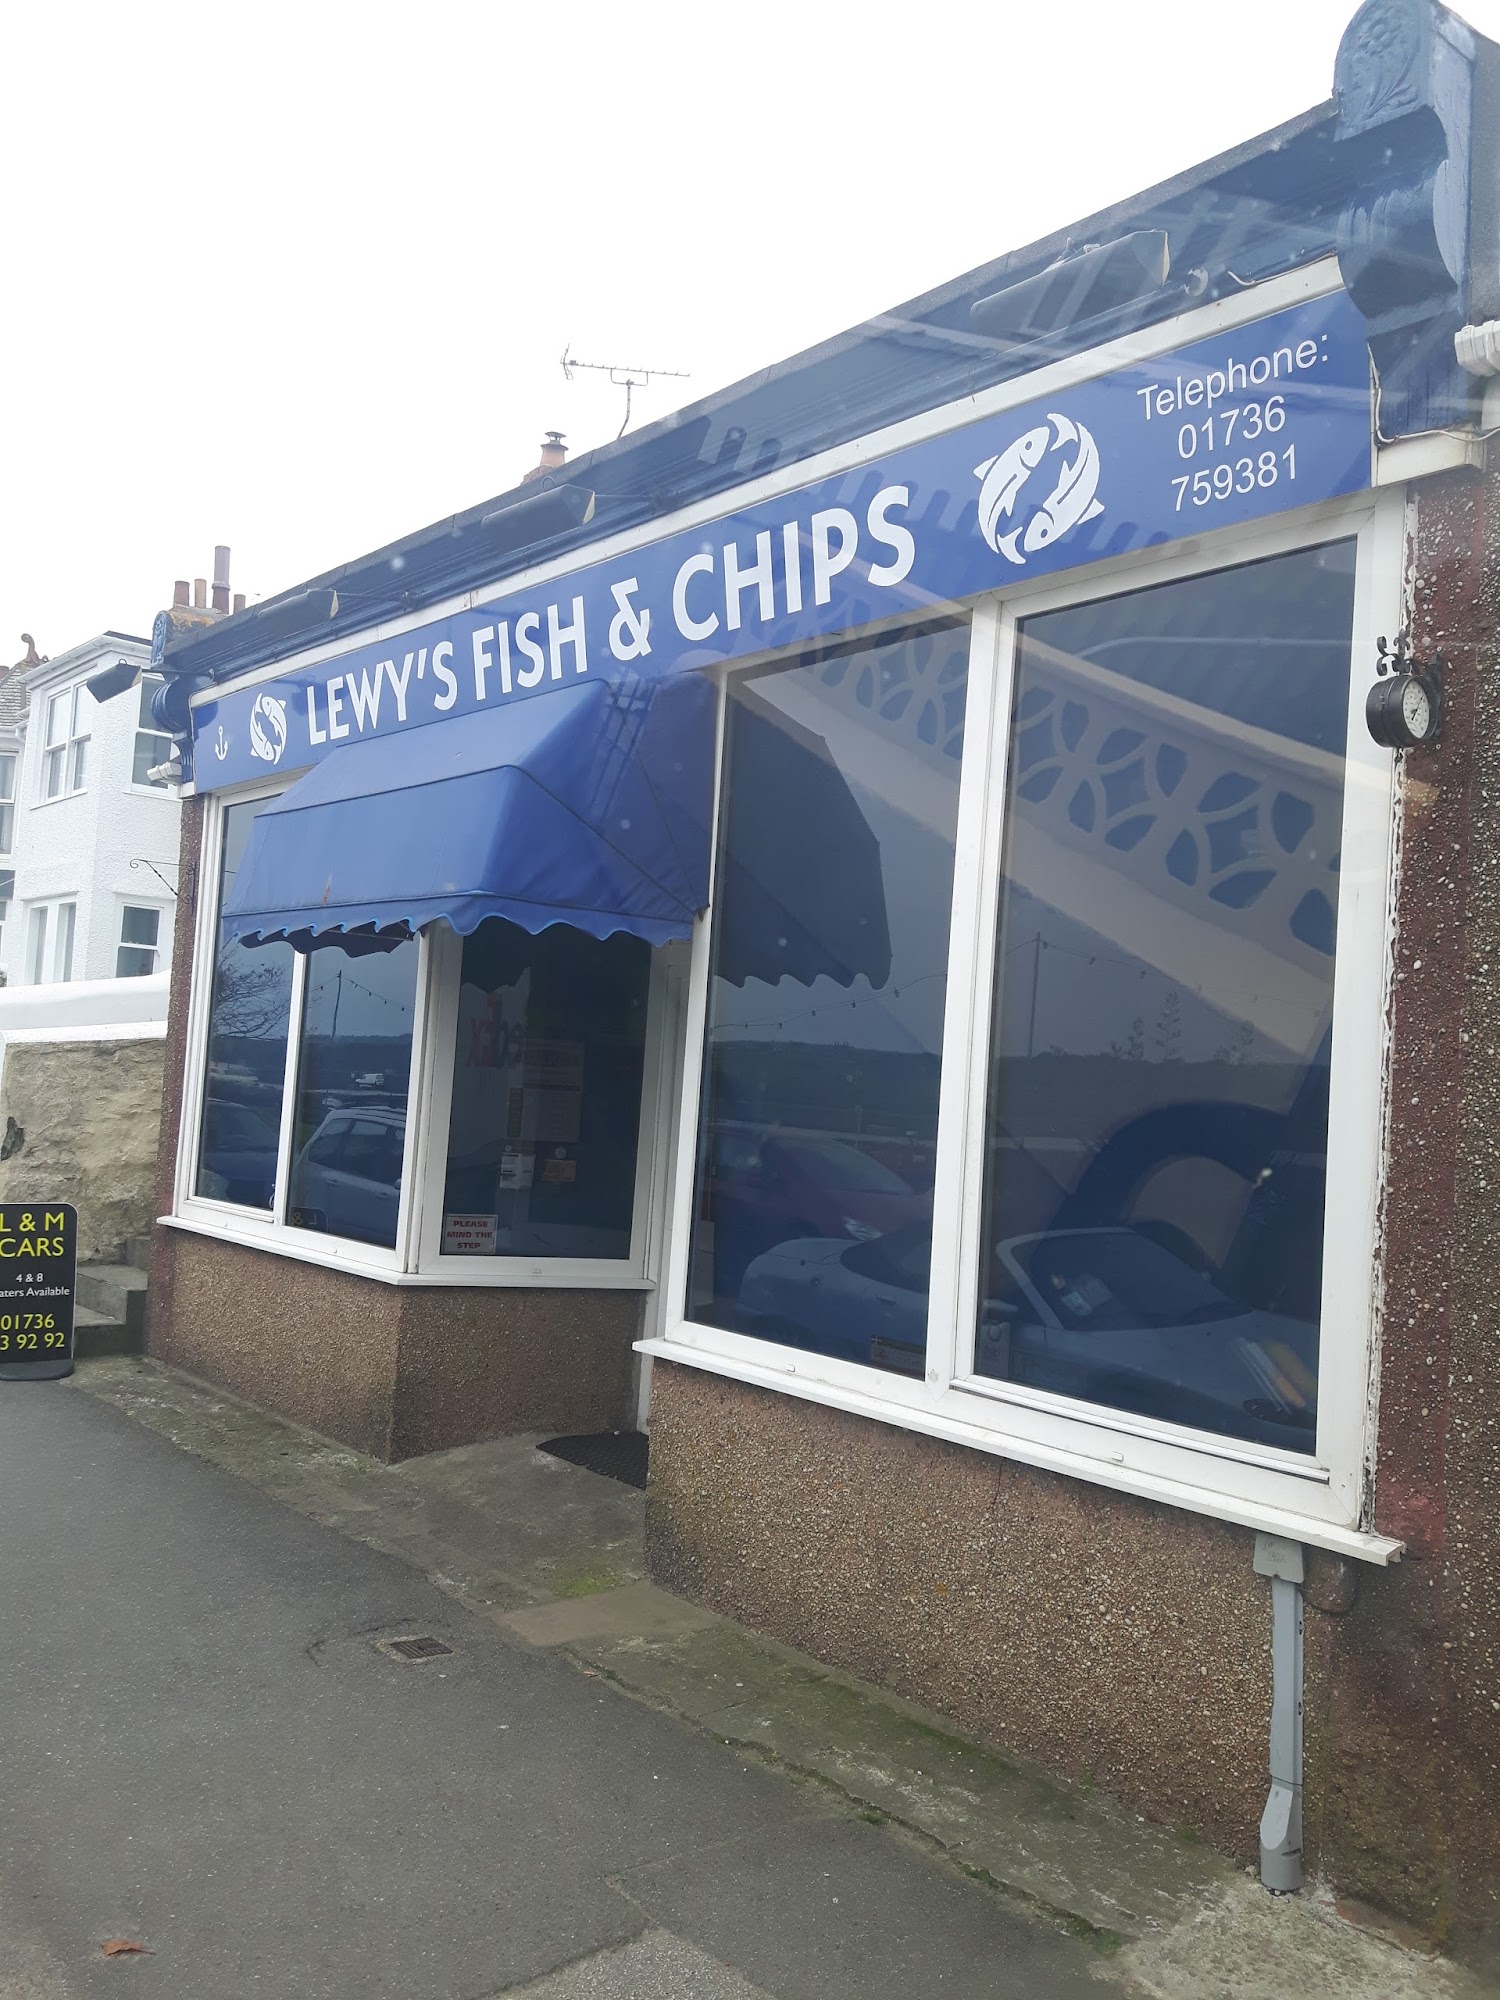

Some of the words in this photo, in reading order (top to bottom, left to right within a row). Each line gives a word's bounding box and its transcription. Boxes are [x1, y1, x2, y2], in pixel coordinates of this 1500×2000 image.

[1136, 334, 1328, 420] Telephone:
[1178, 395, 1286, 459] 01736
[1171, 444, 1296, 512] 759381
[306, 641, 458, 746] LEWY'S
[472, 596, 588, 702] FISH
[609, 578, 652, 661] &
[673, 486, 916, 642] CHIPS
[0, 1212, 12, 1232] L
[19, 1212, 36, 1232] &
[45, 1212, 64, 1231] M
[453, 1220, 488, 1228] PLEASE
[475, 1231, 493, 1239] THE
[0, 1237, 64, 1257] CARS
[16, 1273, 23, 1283] 4
[25, 1273, 34, 1283] &
[36, 1272, 44, 1282] 8
[26, 1286, 71, 1297] Available
[1, 1313, 55, 1331] 01736
[16, 1334, 38, 1350] 92
[44, 1332, 65, 1348] 92
